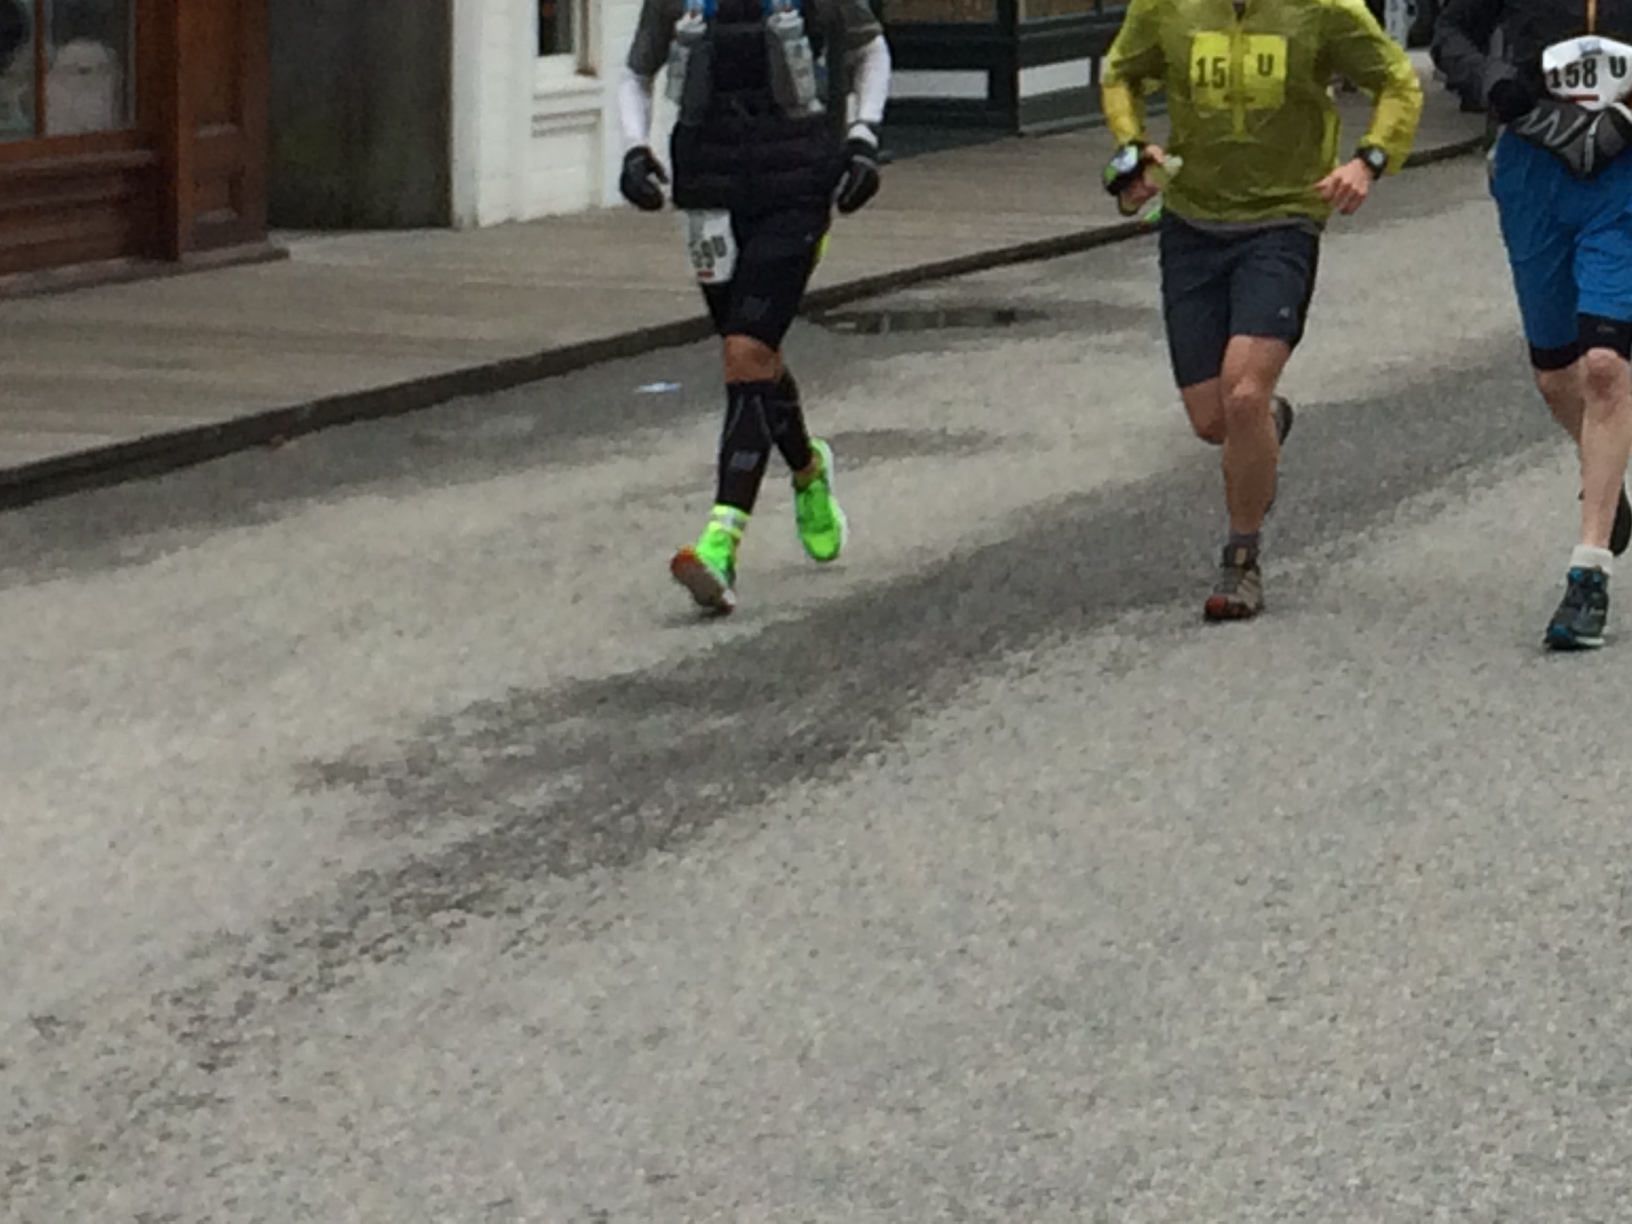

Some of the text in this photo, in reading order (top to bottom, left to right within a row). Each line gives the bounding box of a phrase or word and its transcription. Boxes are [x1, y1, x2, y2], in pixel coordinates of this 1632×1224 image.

[1257, 54, 1275, 78] U
[1548, 56, 1626, 89] 158 U
